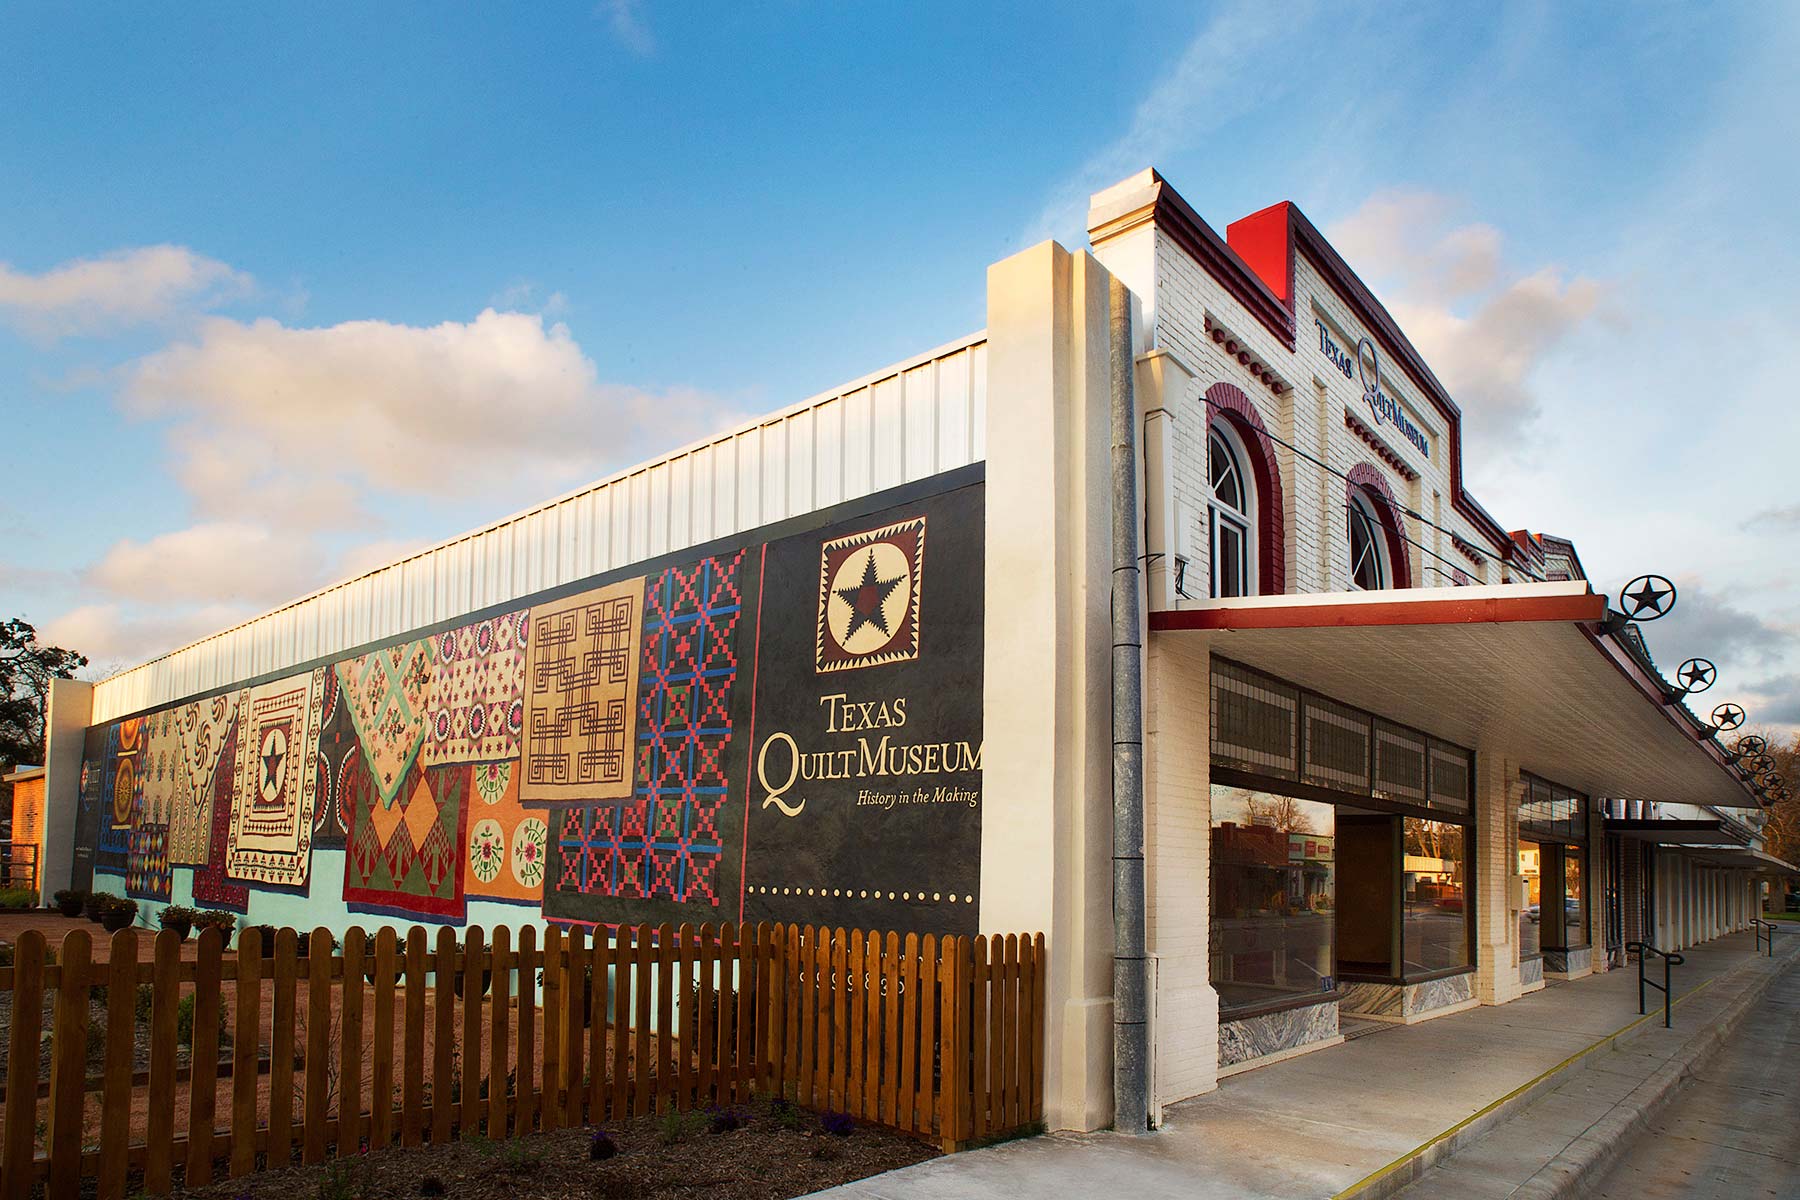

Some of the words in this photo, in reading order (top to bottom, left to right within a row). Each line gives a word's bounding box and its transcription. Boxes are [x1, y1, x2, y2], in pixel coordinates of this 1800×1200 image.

[1315, 318, 1352, 379] TEXAS
[820, 693, 907, 733] TEXAS
[857, 789, 897, 810] History
[898, 790, 910, 804] in
[912, 787, 930, 804] the
[931, 786, 979, 808] Making
